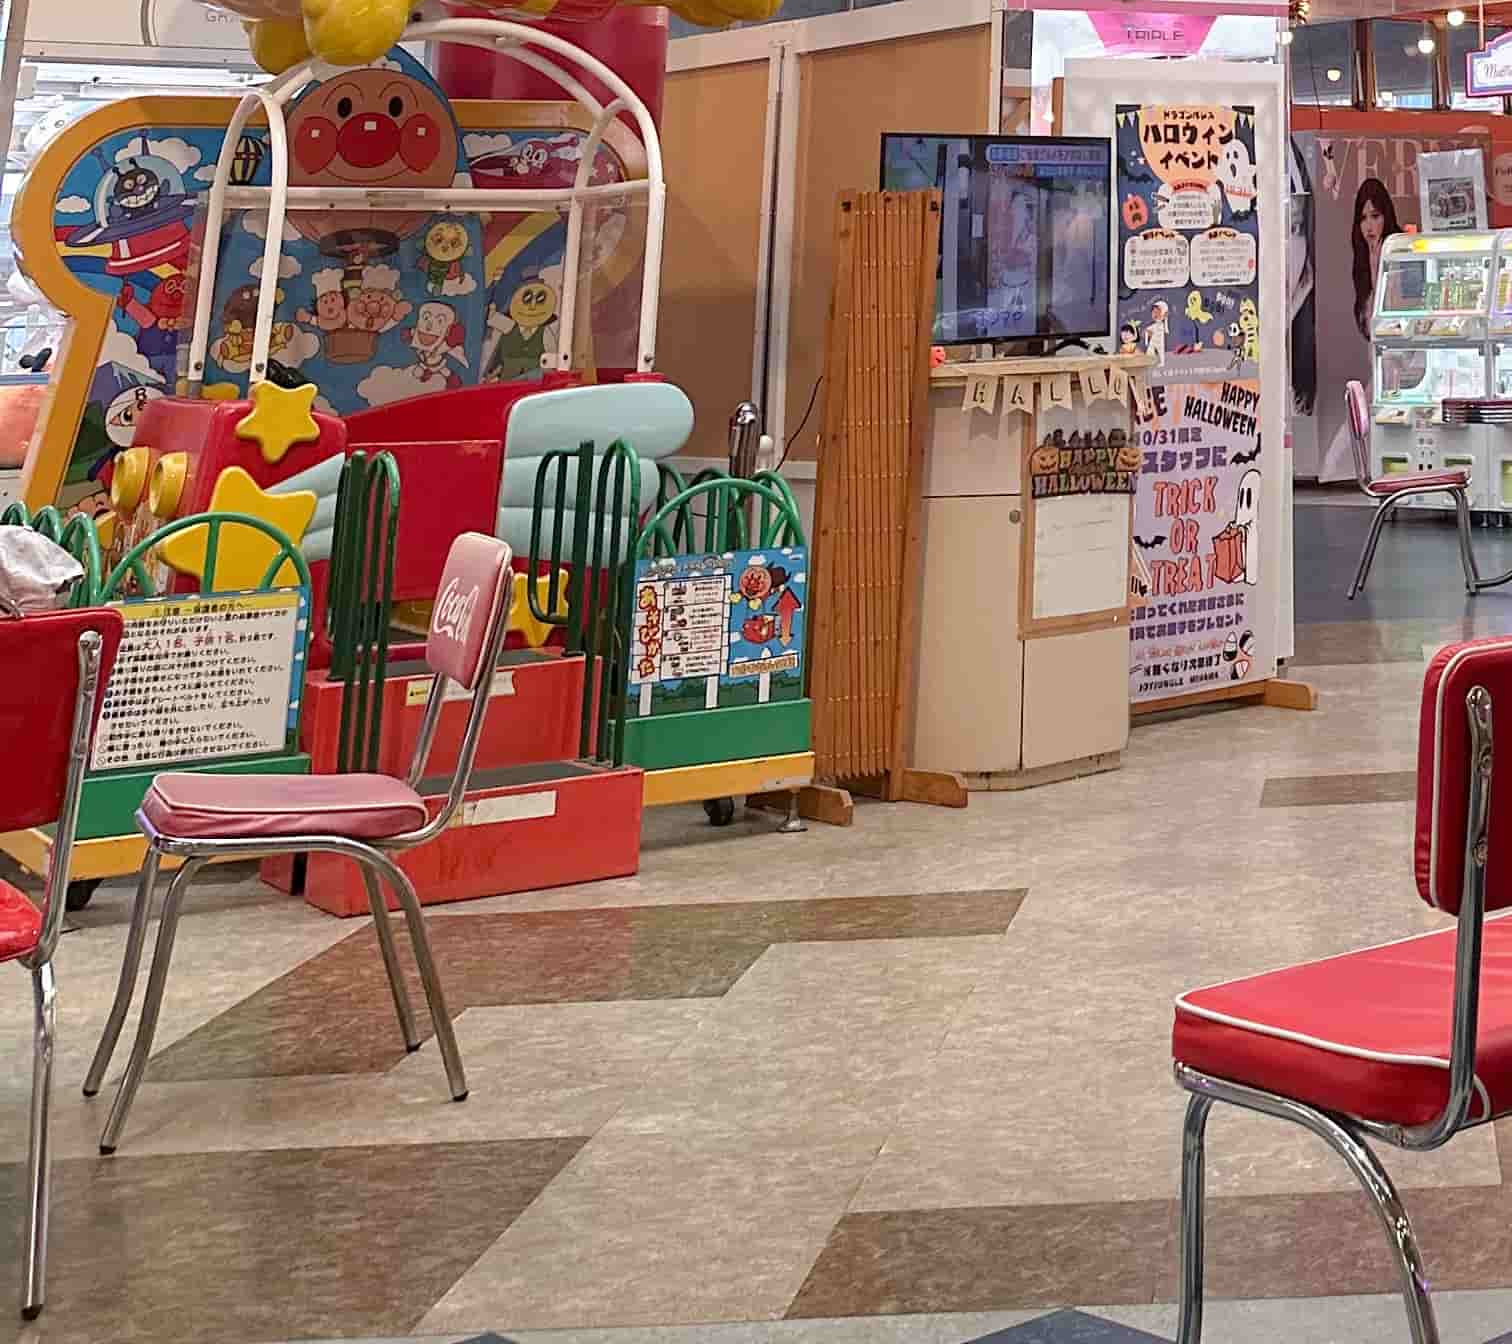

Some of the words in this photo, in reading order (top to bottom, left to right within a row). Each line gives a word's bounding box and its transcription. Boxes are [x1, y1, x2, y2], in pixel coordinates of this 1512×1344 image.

[1143, 122, 1234, 145] ハロウィン
[1159, 150, 1219, 170] イベント
[1220, 381, 1261, 413] HAPPY
[1184, 395, 1257, 437] HALLOWEEN
[1058, 447, 1120, 470] HAPPY
[1034, 471, 1138, 497] HALLOWEEN
[1152, 476, 1218, 518] TRICK
[1169, 517, 1200, 554] OR
[1151, 552, 1217, 597] TREAT
